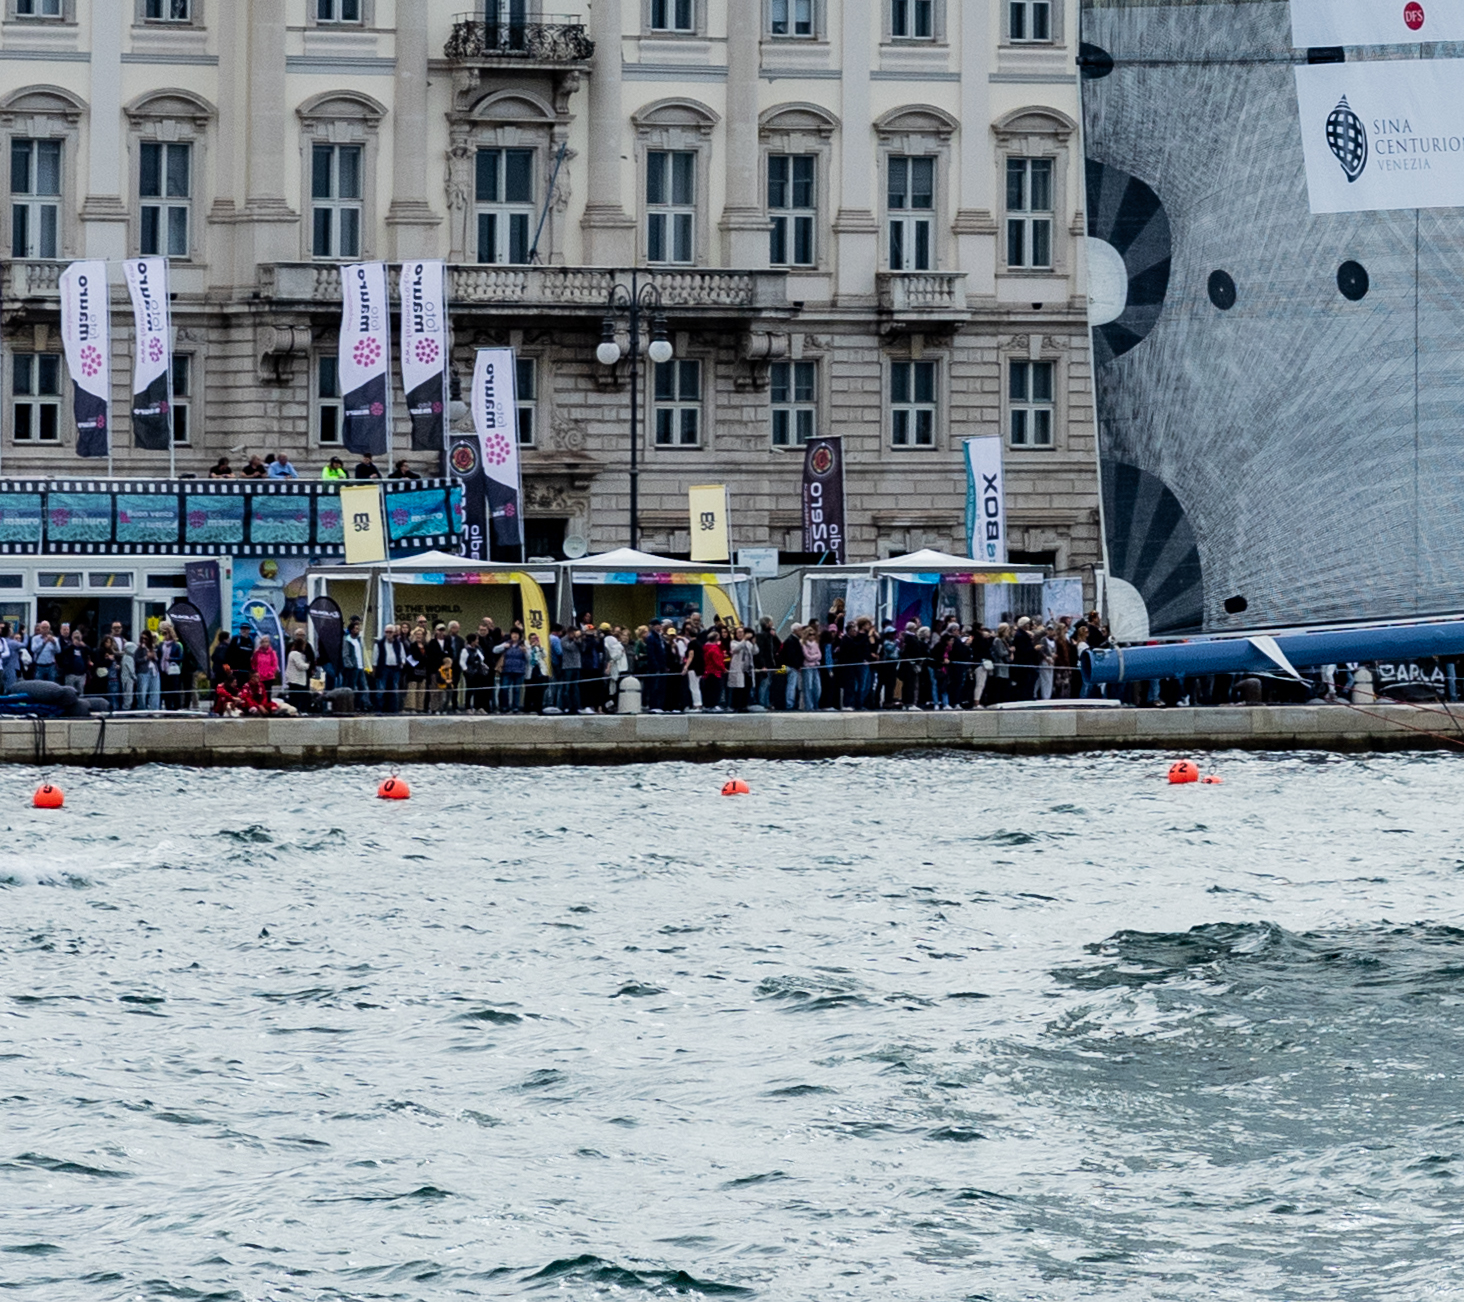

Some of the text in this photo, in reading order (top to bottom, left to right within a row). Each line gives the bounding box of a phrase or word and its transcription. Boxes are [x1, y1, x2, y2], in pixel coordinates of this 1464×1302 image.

[1404, 10, 1424, 23] DFS
[1372, 118, 1413, 136] SINA
[1376, 157, 1432, 172] VENEZIA
